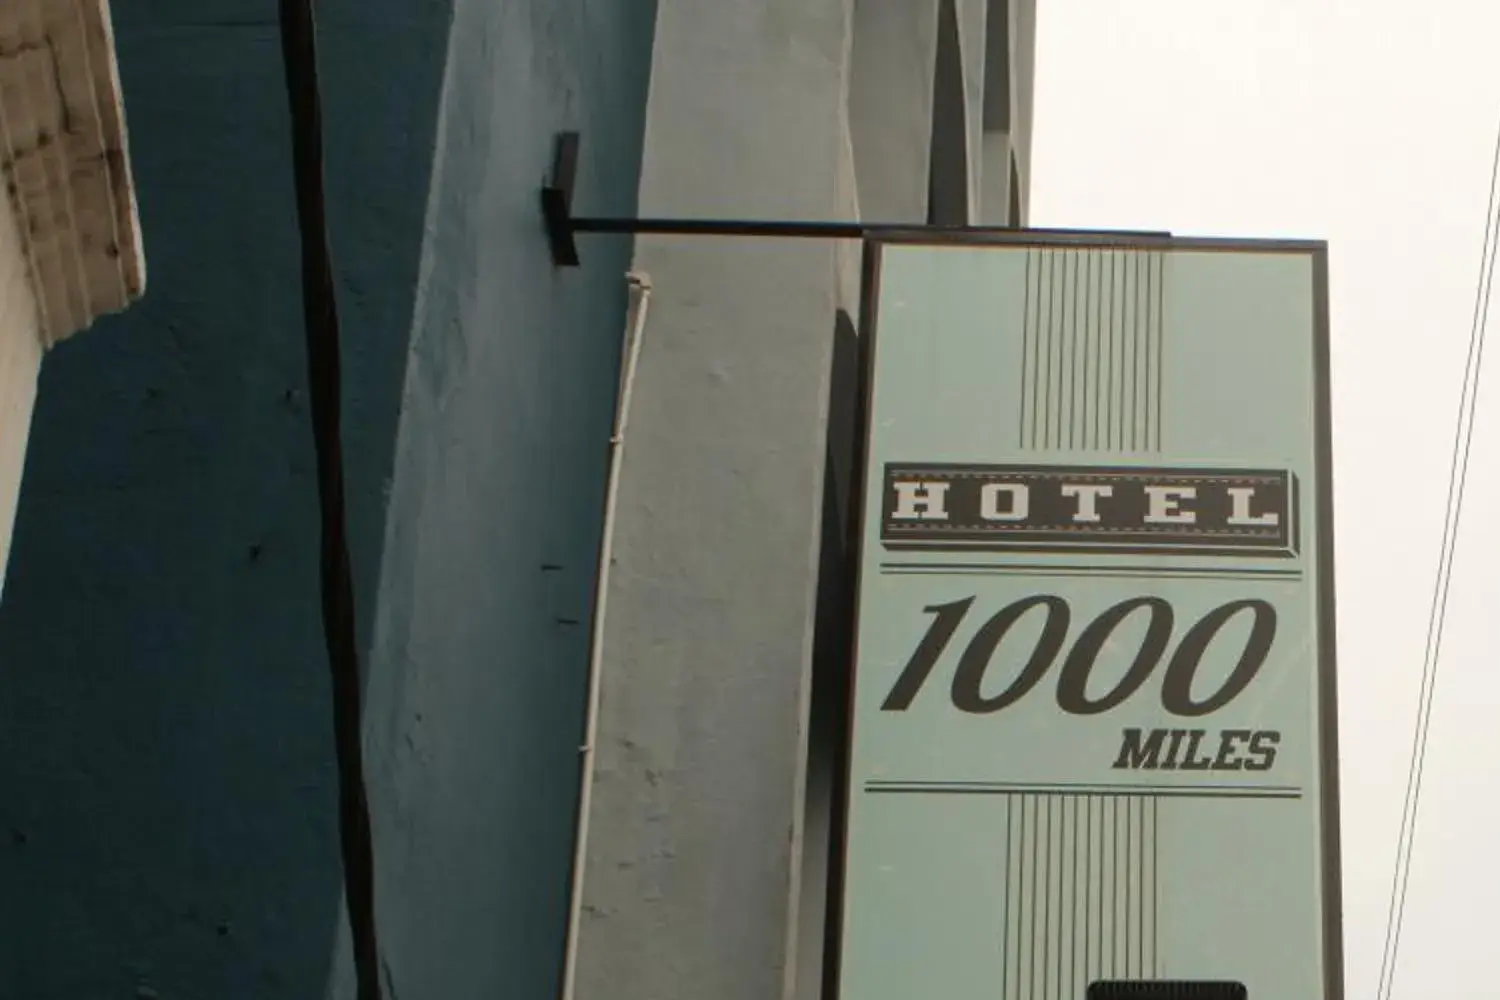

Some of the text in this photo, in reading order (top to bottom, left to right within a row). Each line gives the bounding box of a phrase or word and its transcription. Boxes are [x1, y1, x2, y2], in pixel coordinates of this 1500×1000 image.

[891, 481, 1278, 526] HOTEL
[880, 594, 1278, 717] 1000
[1111, 728, 1281, 772] MILES
